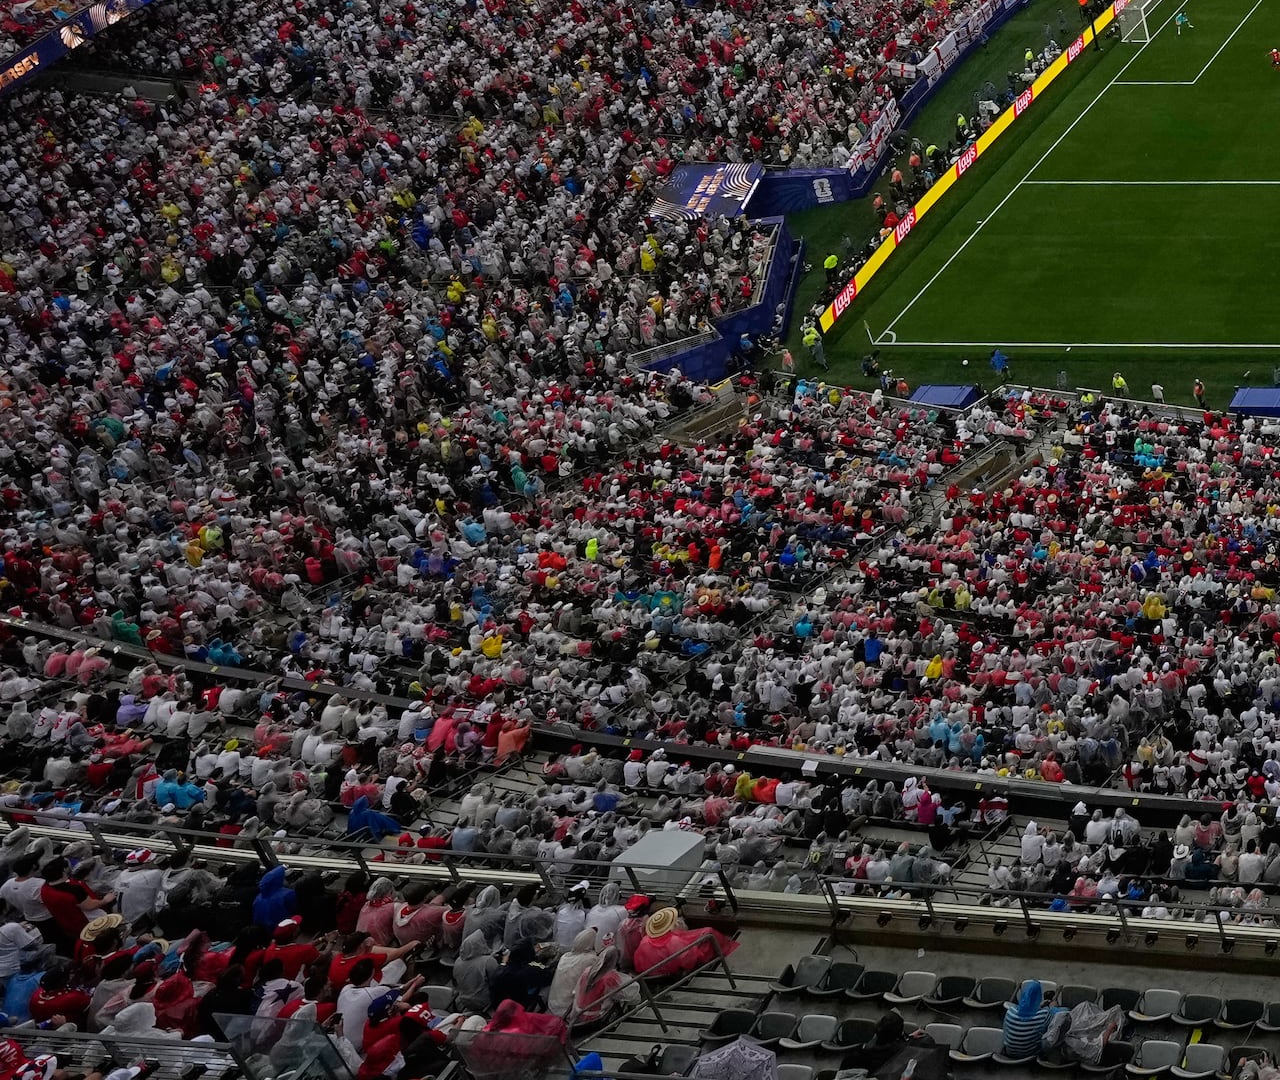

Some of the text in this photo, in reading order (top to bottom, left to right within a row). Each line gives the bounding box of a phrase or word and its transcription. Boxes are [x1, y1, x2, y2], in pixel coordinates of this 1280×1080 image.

[1068, 36, 1083, 62] Lay's
[1015, 89, 1033, 117] Lay's
[957, 146, 976, 176] Lay's
[896, 211, 915, 246] Lay's
[834, 283, 855, 318] Lay's
